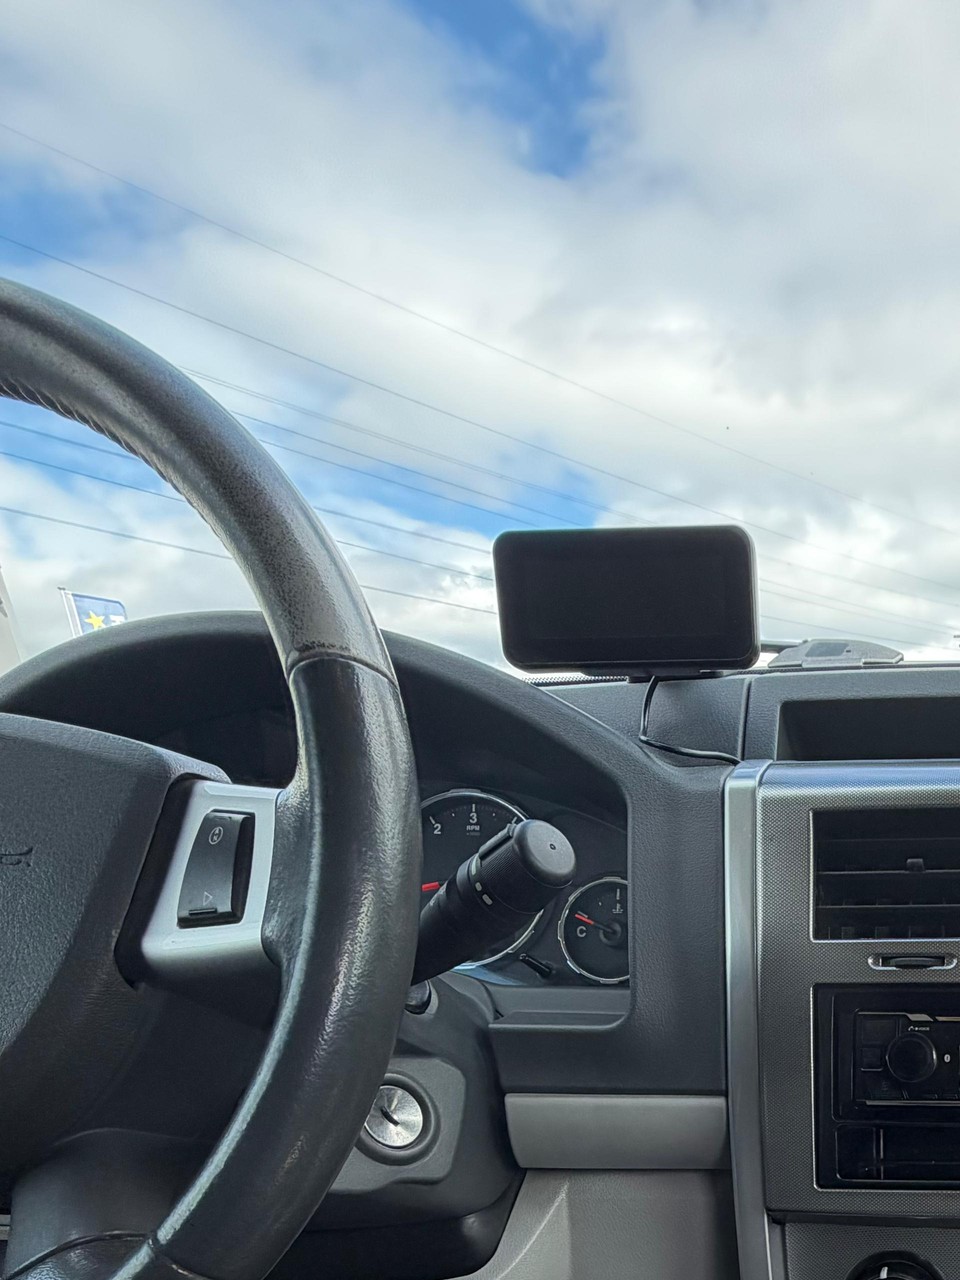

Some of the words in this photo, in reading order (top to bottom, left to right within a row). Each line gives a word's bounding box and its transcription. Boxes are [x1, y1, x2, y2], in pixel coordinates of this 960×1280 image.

[469, 812, 478, 824] 3
[433, 823, 442, 835] 2
[576, 925, 587, 938] C
